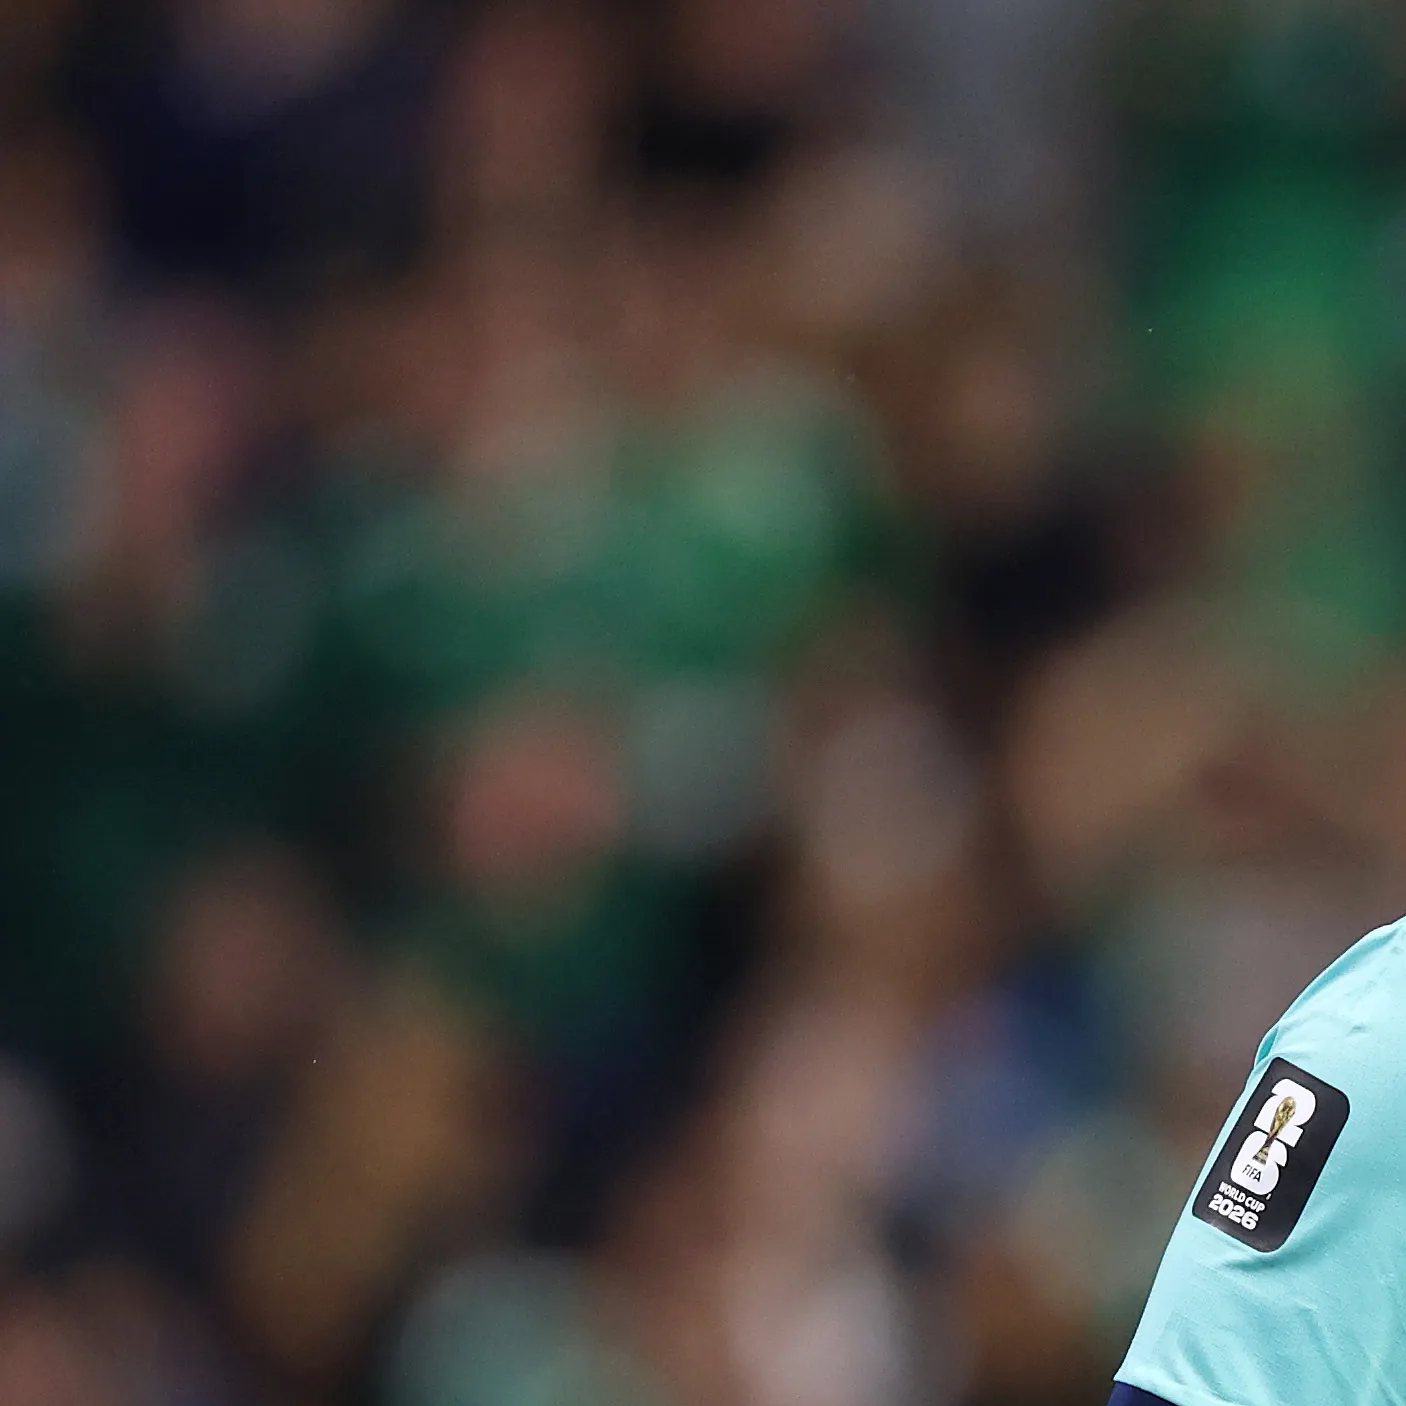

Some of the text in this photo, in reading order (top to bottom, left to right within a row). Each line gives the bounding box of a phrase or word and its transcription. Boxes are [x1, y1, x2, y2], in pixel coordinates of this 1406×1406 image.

[1241, 1164, 1262, 1182] FIFA
[1208, 1193, 1259, 1230] 2026
[1218, 1181, 1266, 1213] WORLD CUP
